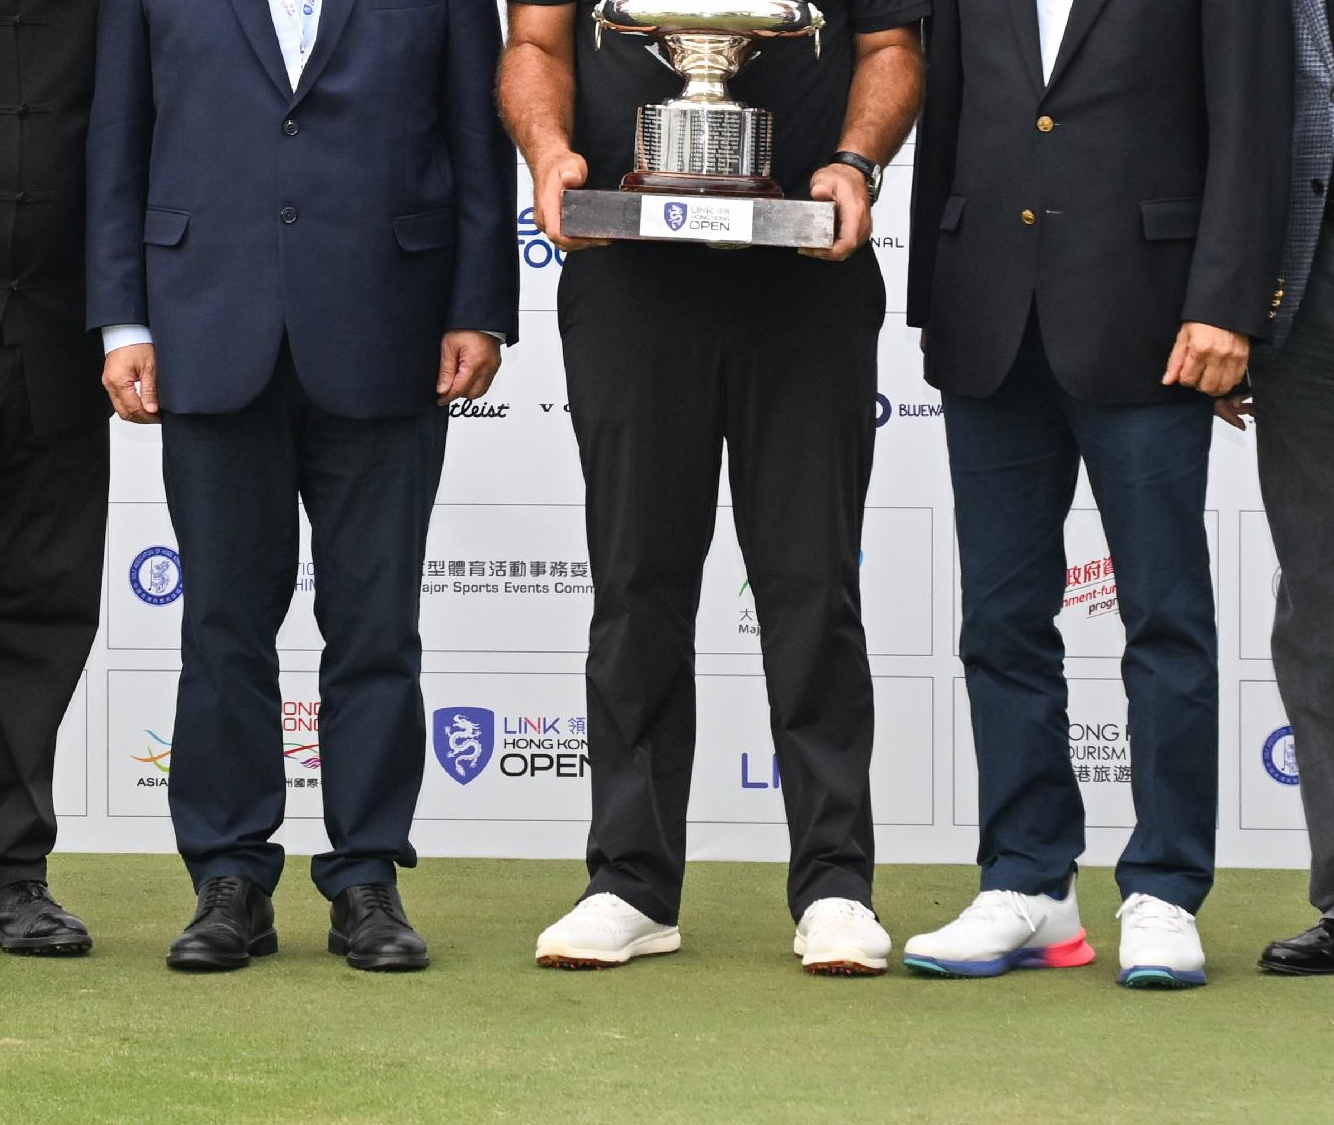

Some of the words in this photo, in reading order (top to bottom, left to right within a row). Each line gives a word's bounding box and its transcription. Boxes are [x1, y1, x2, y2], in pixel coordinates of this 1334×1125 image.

[689, 221, 730, 231] OPEN
[449, 399, 510, 418] tleist
[898, 404, 946, 418] BLUEWA
[422, 582, 448, 595] ajor
[453, 581, 499, 595] Sports
[505, 581, 550, 594] Events
[505, 717, 560, 734] LINK
[568, 717, 586, 734] 領
[1069, 723, 1120, 742] ONG
[505, 737, 554, 750] HONG
